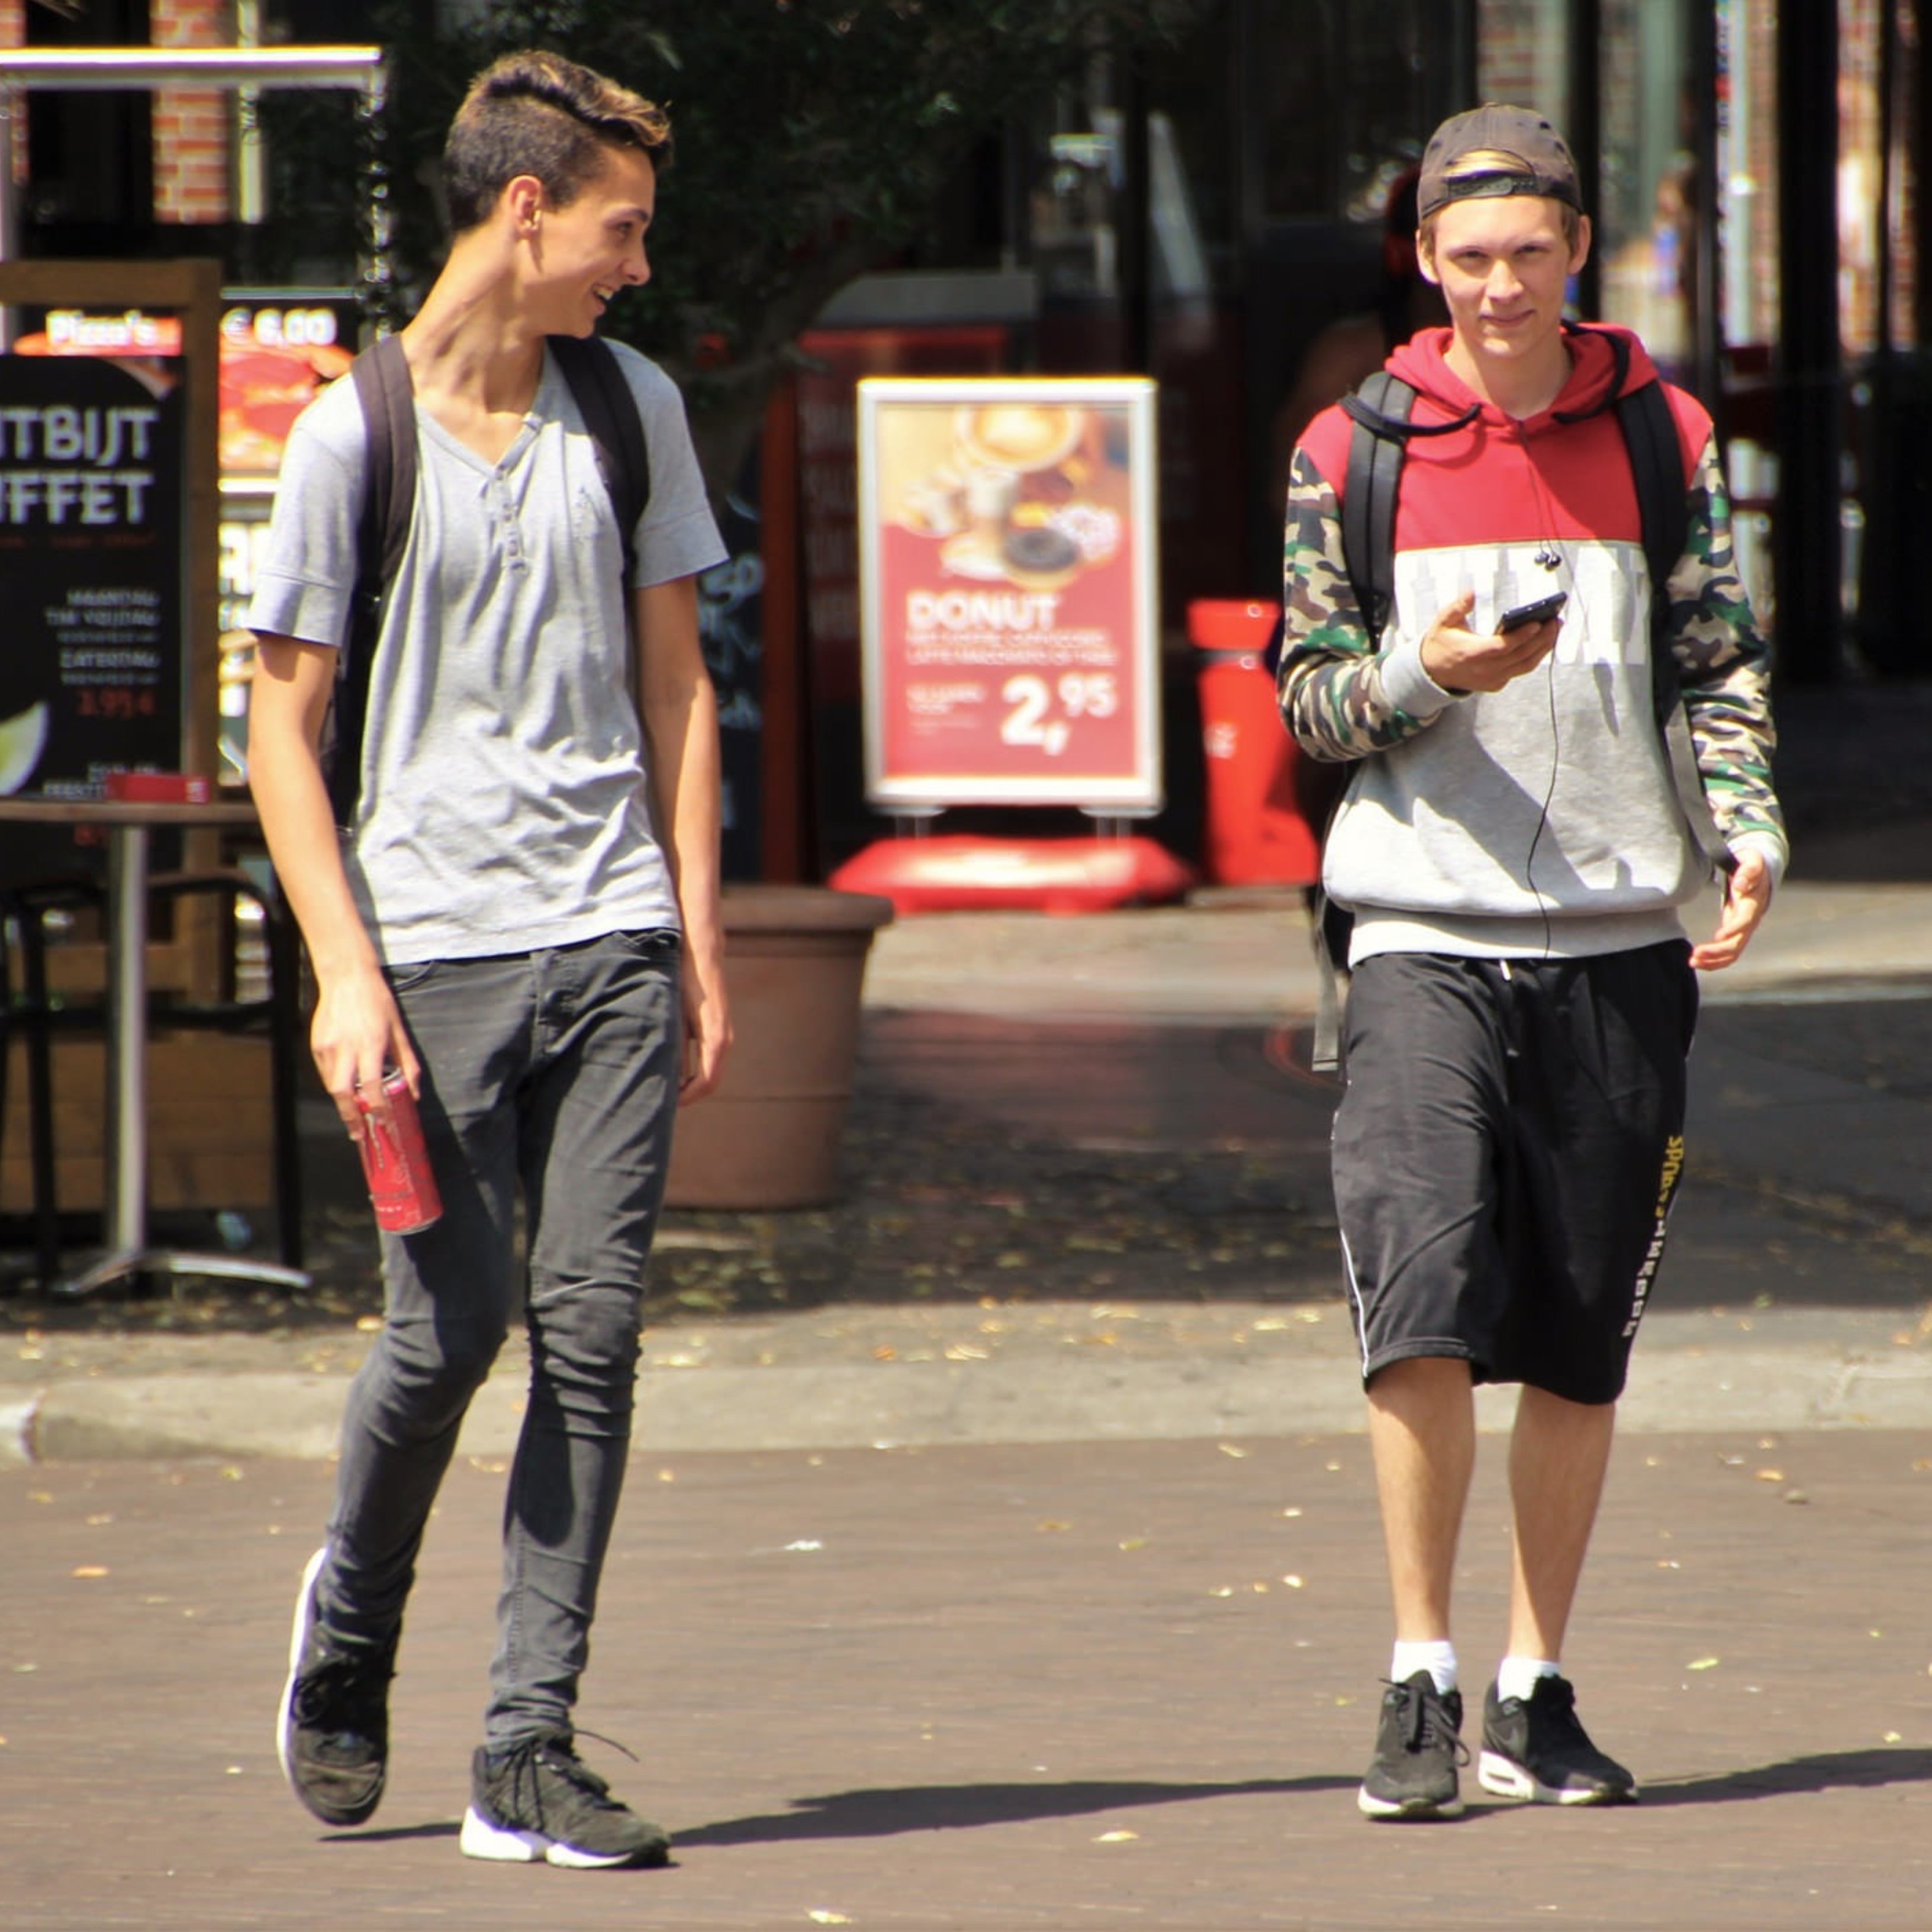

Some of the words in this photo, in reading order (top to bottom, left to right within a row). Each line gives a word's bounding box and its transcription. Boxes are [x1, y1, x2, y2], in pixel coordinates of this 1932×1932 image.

[0, 405, 159, 466] TBIJT
[0, 469, 155, 524] FFET
[906, 593, 1058, 630] DONUT
